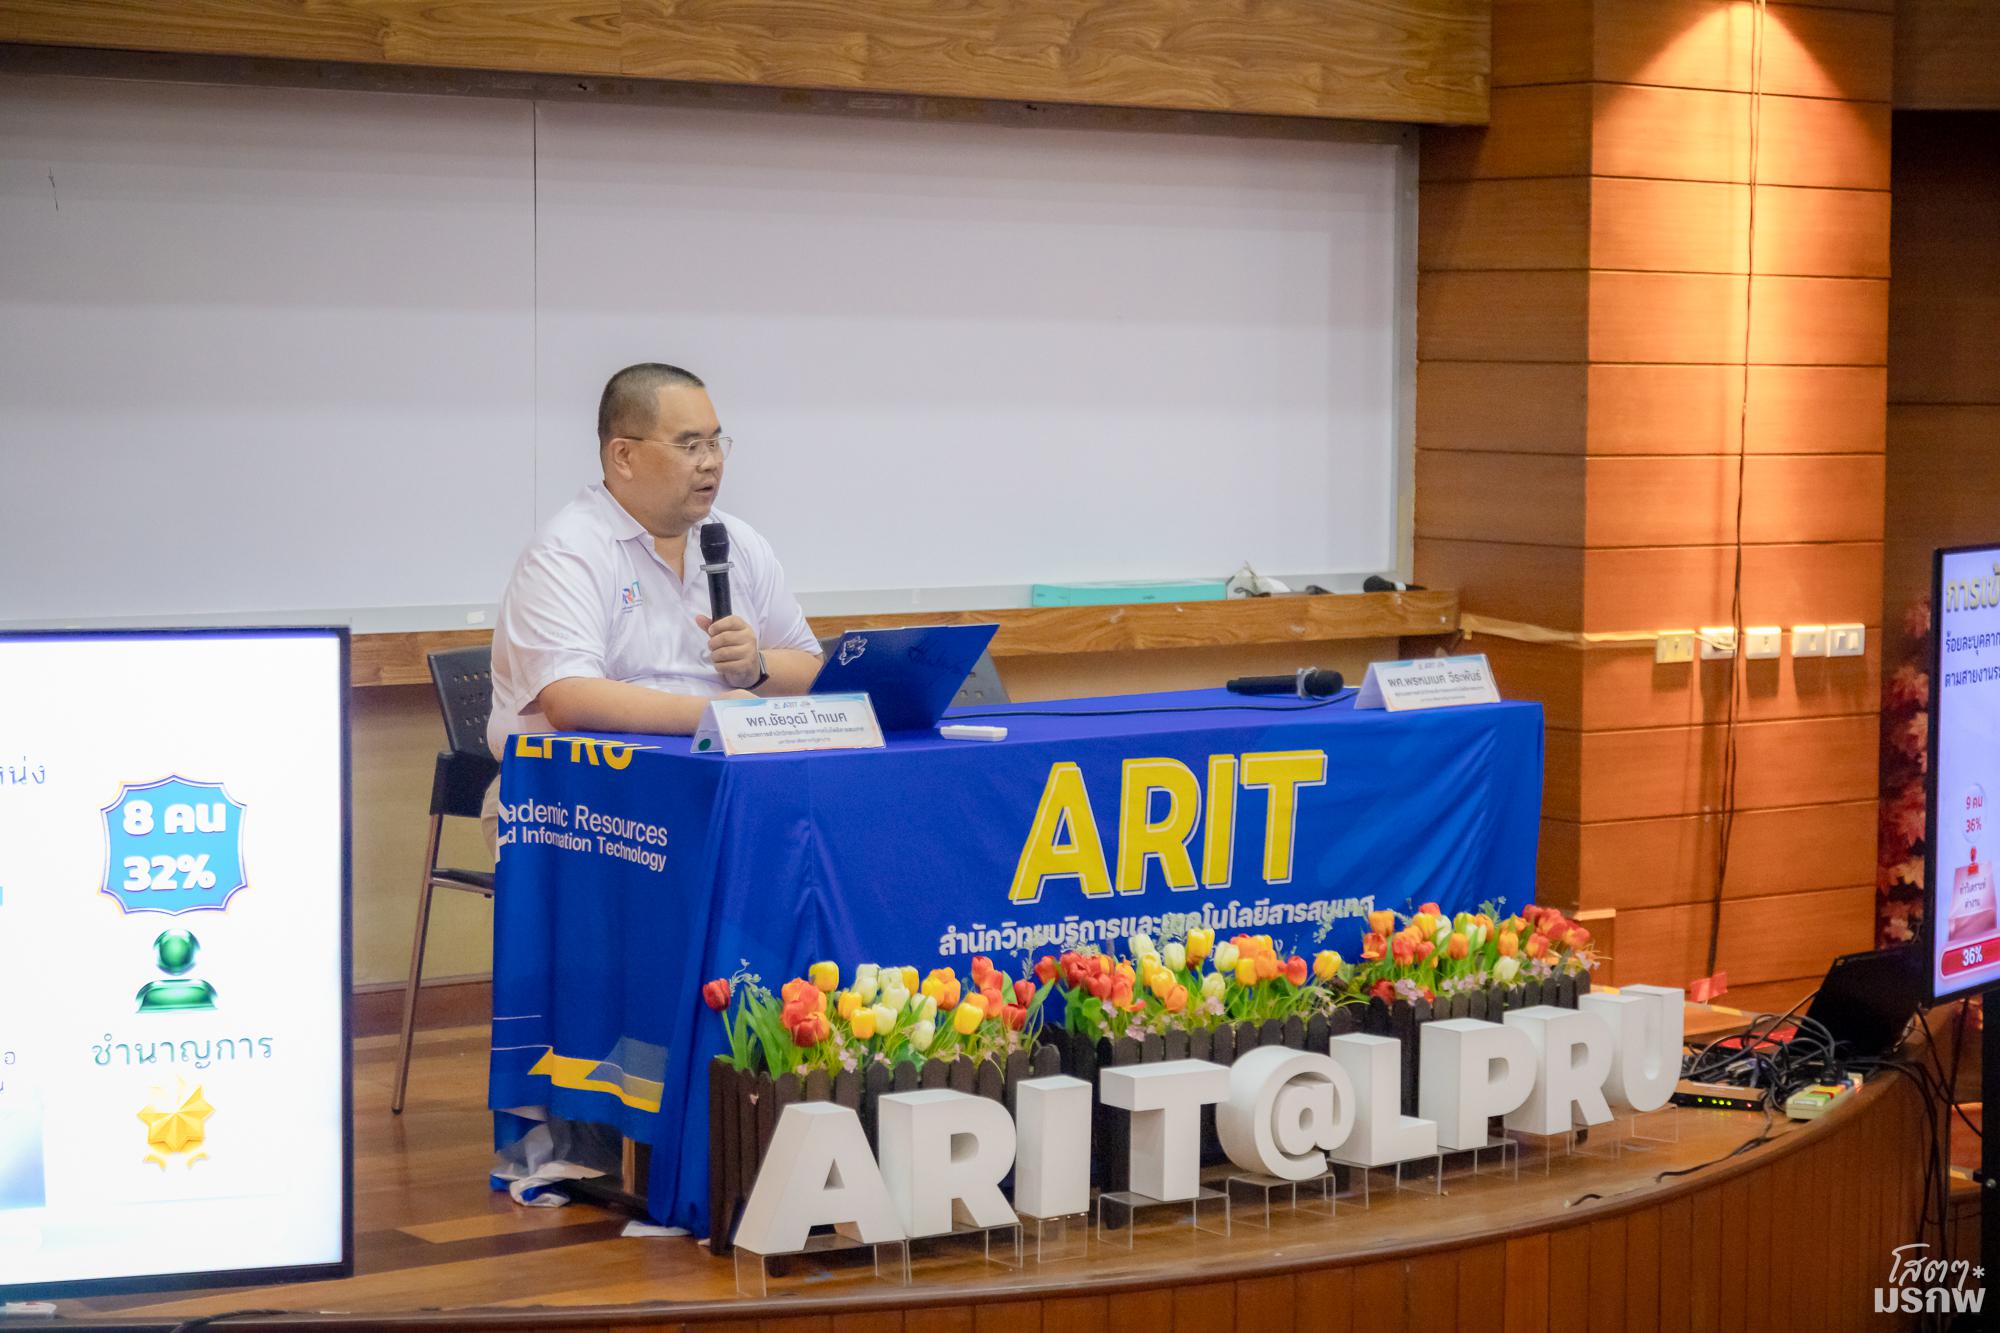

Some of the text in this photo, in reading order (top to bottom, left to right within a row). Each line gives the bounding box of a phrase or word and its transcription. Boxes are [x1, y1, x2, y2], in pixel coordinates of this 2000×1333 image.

[746, 708, 848, 732] ผศ.ชัยวุฒิ โกเมศ
[123, 799, 227, 836] 8 คน
[1965, 796, 1971, 811] 9
[574, 804, 668, 847] Resources
[1008, 749, 1328, 905] ARIT
[1965, 818, 1982, 834] 36%
[596, 836, 668, 873] Technology
[123, 854, 217, 892] 32%
[1962, 945, 1983, 967] 36%
[92, 1033, 273, 1069] ชำนาญการ
